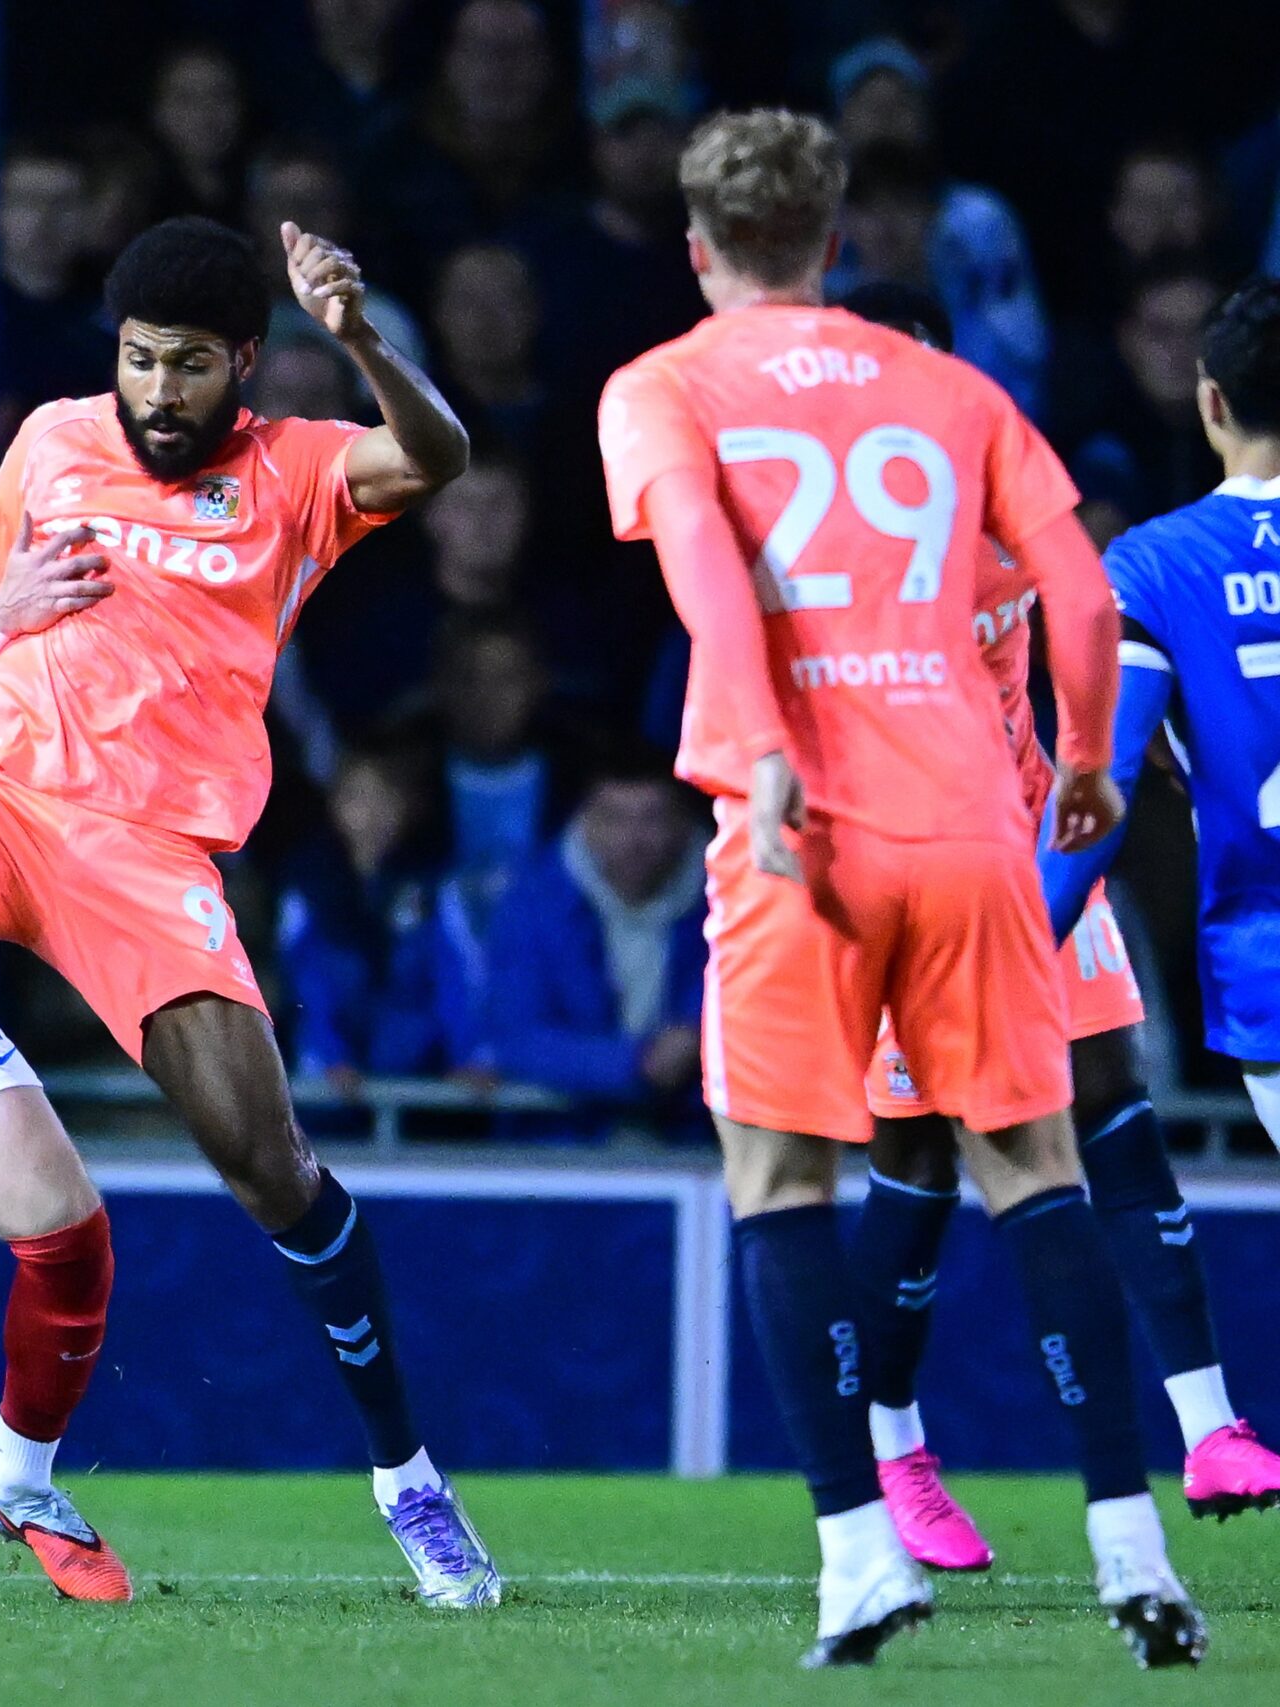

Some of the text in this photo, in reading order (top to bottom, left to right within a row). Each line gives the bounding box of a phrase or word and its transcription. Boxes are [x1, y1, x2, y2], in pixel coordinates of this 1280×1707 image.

[759, 347, 880, 395] TORP
[717, 424, 957, 614] 29
[183, 885, 227, 952] 9
[1072, 903, 1127, 981] 10
